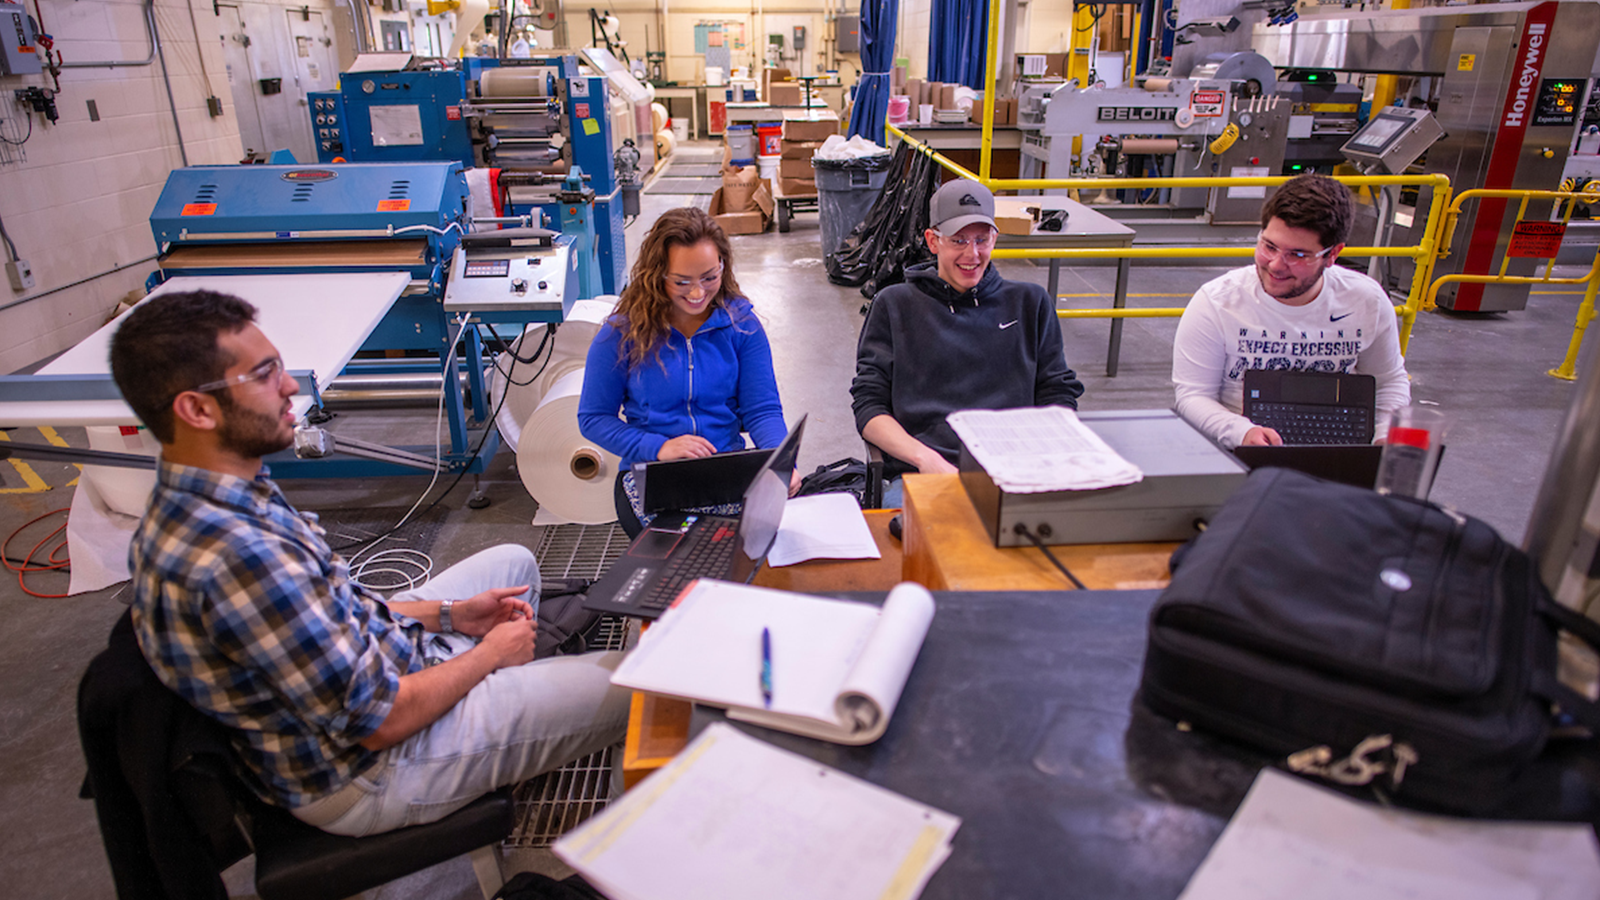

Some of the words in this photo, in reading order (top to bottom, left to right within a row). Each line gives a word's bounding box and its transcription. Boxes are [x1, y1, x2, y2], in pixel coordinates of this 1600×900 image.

[1505, 23, 1546, 127] Honeywell
[1195, 94, 1221, 102] DANGER
[1100, 108, 1175, 120] BELOIT
[1520, 224, 1562, 234] WARNING
[1238, 340, 1287, 354] EXPECT
[1291, 341, 1361, 356] EXCESSIVE
